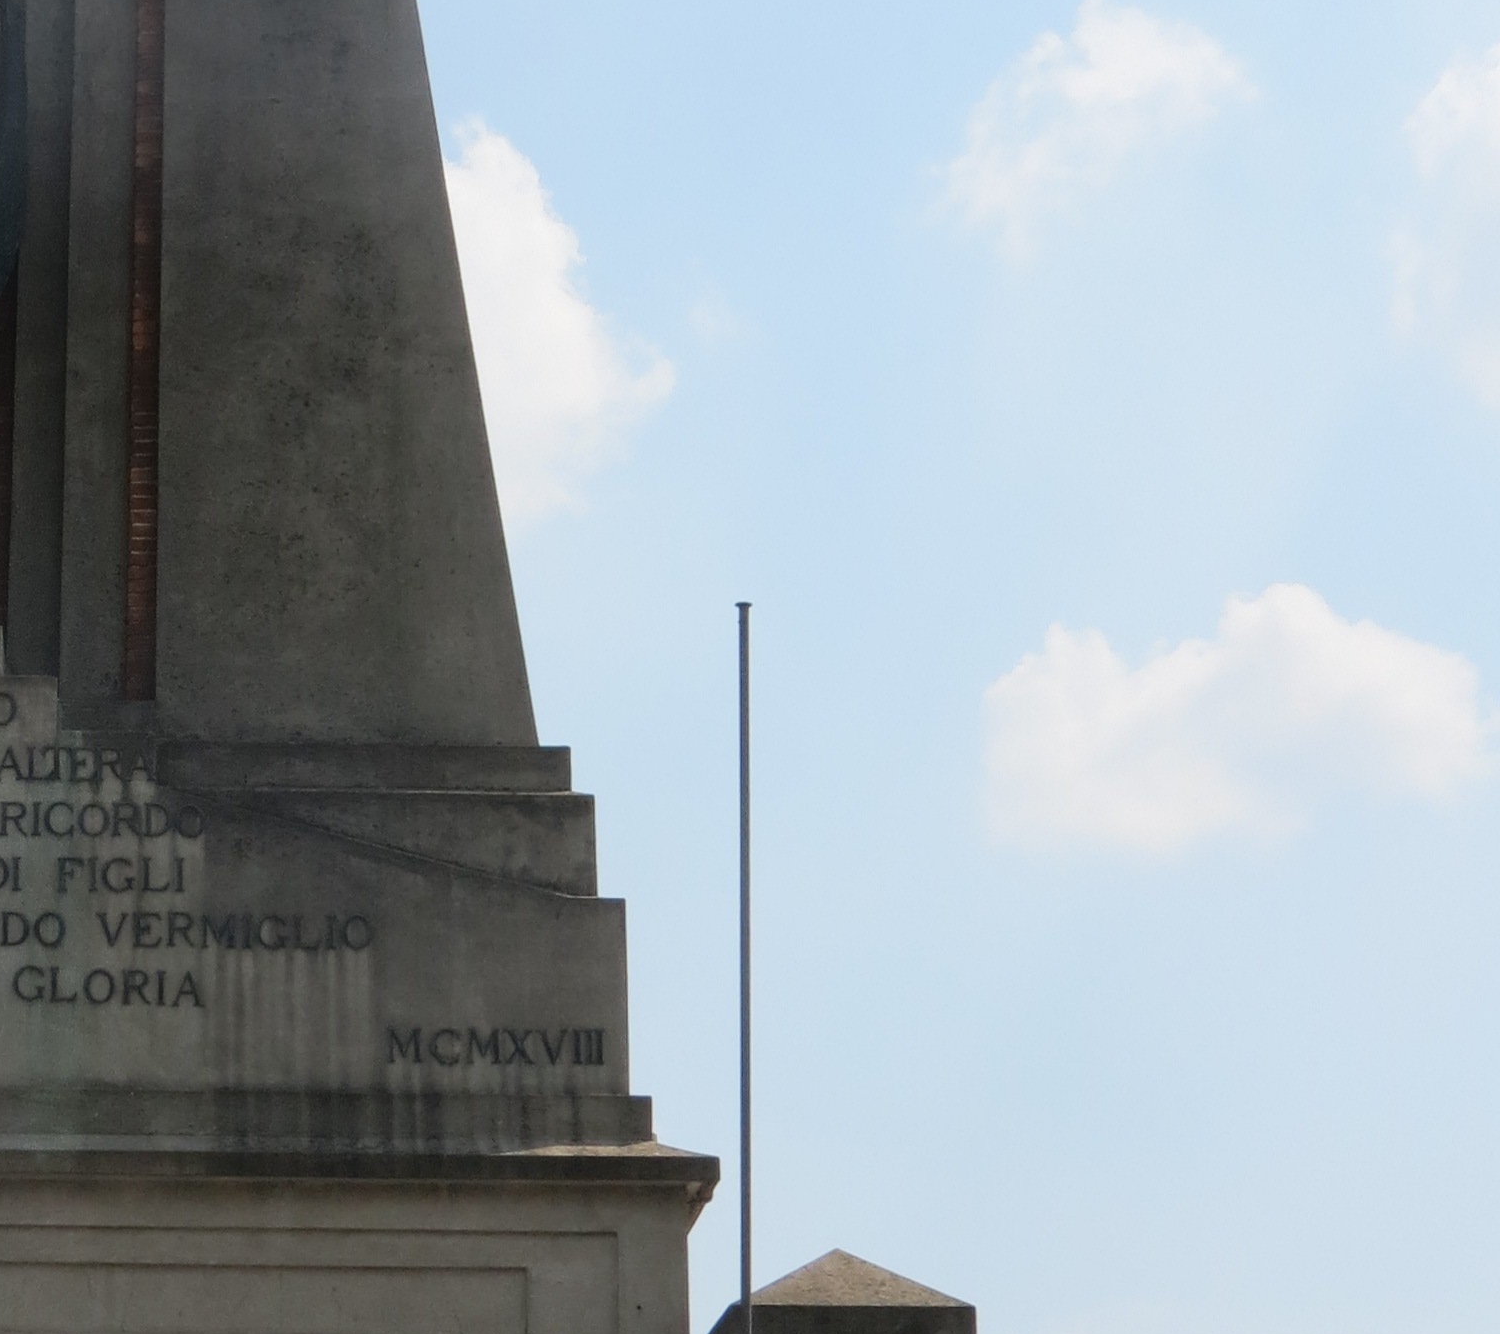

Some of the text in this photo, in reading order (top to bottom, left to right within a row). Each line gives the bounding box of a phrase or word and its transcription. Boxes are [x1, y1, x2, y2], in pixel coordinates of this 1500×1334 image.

[0, 801, 206, 841] RICORDO
[56, 857, 185, 895] FIGLI
[98, 911, 376, 952] VERMIGLIO
[12, 965, 206, 1009] GLORIA
[386, 1026, 607, 1066] MCMXVIII
